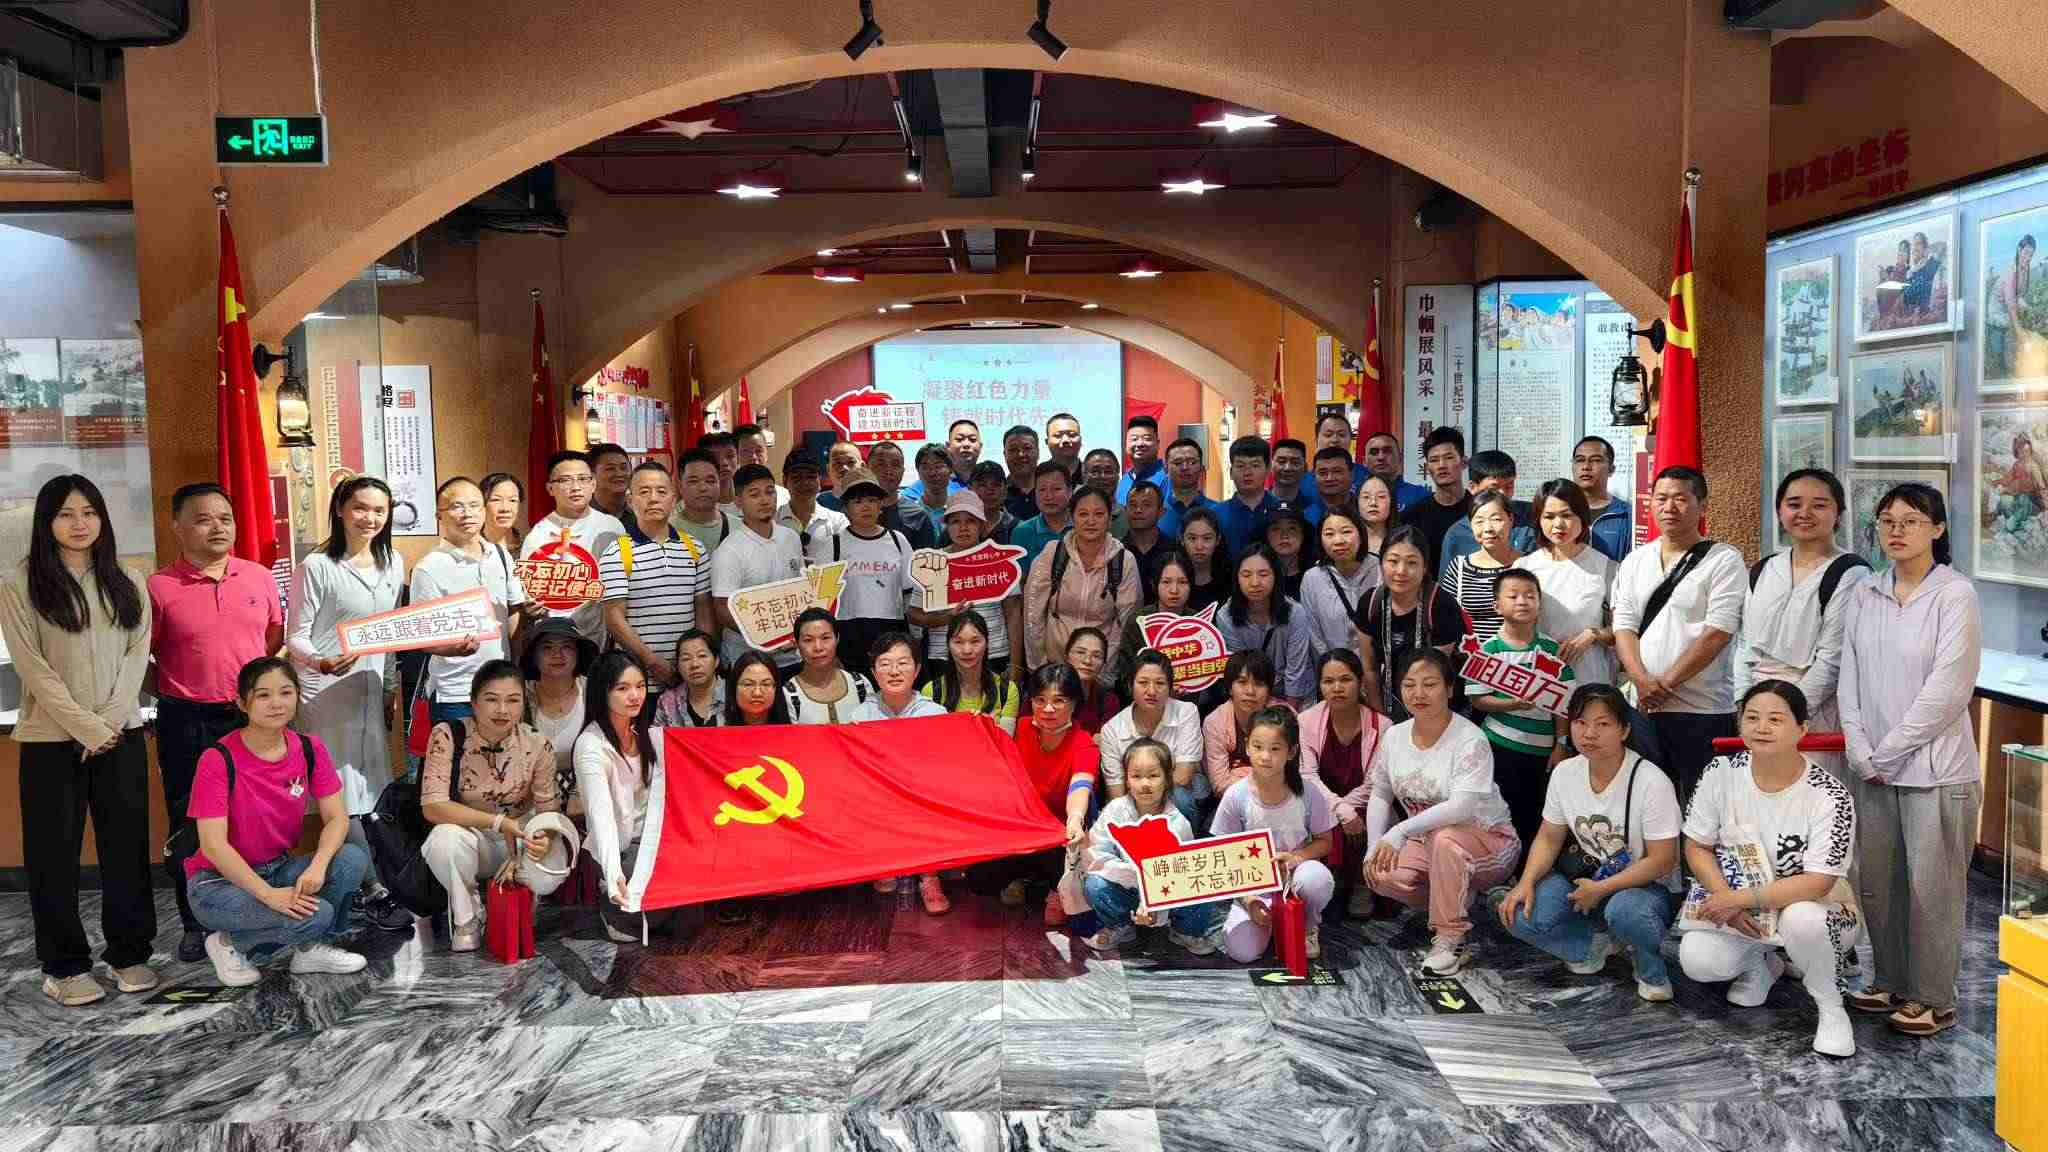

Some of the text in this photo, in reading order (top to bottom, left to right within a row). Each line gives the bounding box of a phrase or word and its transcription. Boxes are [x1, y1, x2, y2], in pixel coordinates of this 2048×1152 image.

[922, 379, 1051, 400] 凝聚红色力量
[857, 406, 917, 418] 奋进新征程
[942, 406, 1072, 428] 铸就时代先
[857, 417, 917, 430] 建功新时代
[514, 560, 592, 580] 不忘初心
[846, 560, 897, 573] AMERA
[528, 579, 604, 598] 牢记使命
[952, 569, 1010, 591] 奋进新时代
[750, 591, 815, 616] 不忘初心
[357, 608, 476, 644] 永远跟着党走
[755, 609, 802, 633] 牢记使
[1173, 656, 1230, 681] 辈当自强
[1461, 653, 1569, 715] 祖国万
[1152, 850, 1228, 878] 峥嵘岁月
[1188, 866, 1265, 893] 不忘初心
